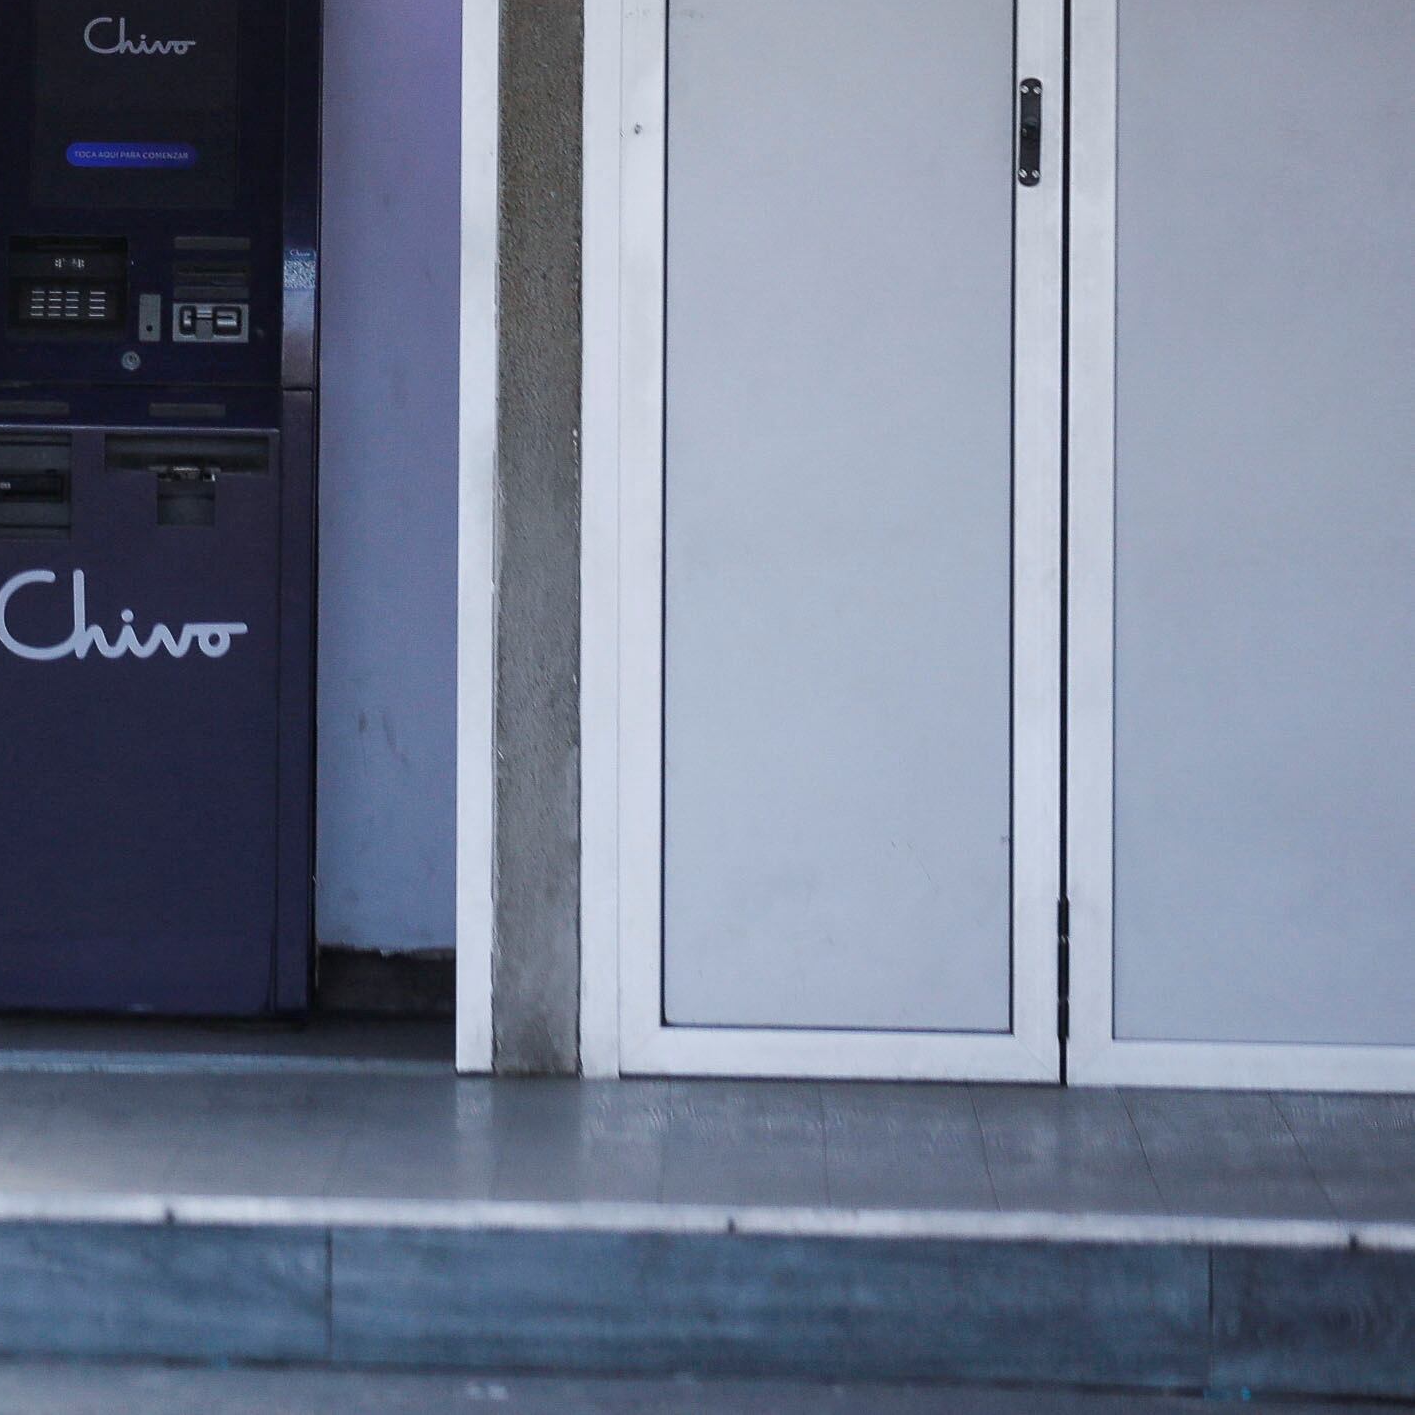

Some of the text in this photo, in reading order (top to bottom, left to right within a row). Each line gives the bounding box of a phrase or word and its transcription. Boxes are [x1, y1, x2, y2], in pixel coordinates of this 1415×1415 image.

[83, 16, 197, 55] Chivo
[119, 149, 141, 160] PARA
[142, 151, 189, 161] COMENZAR
